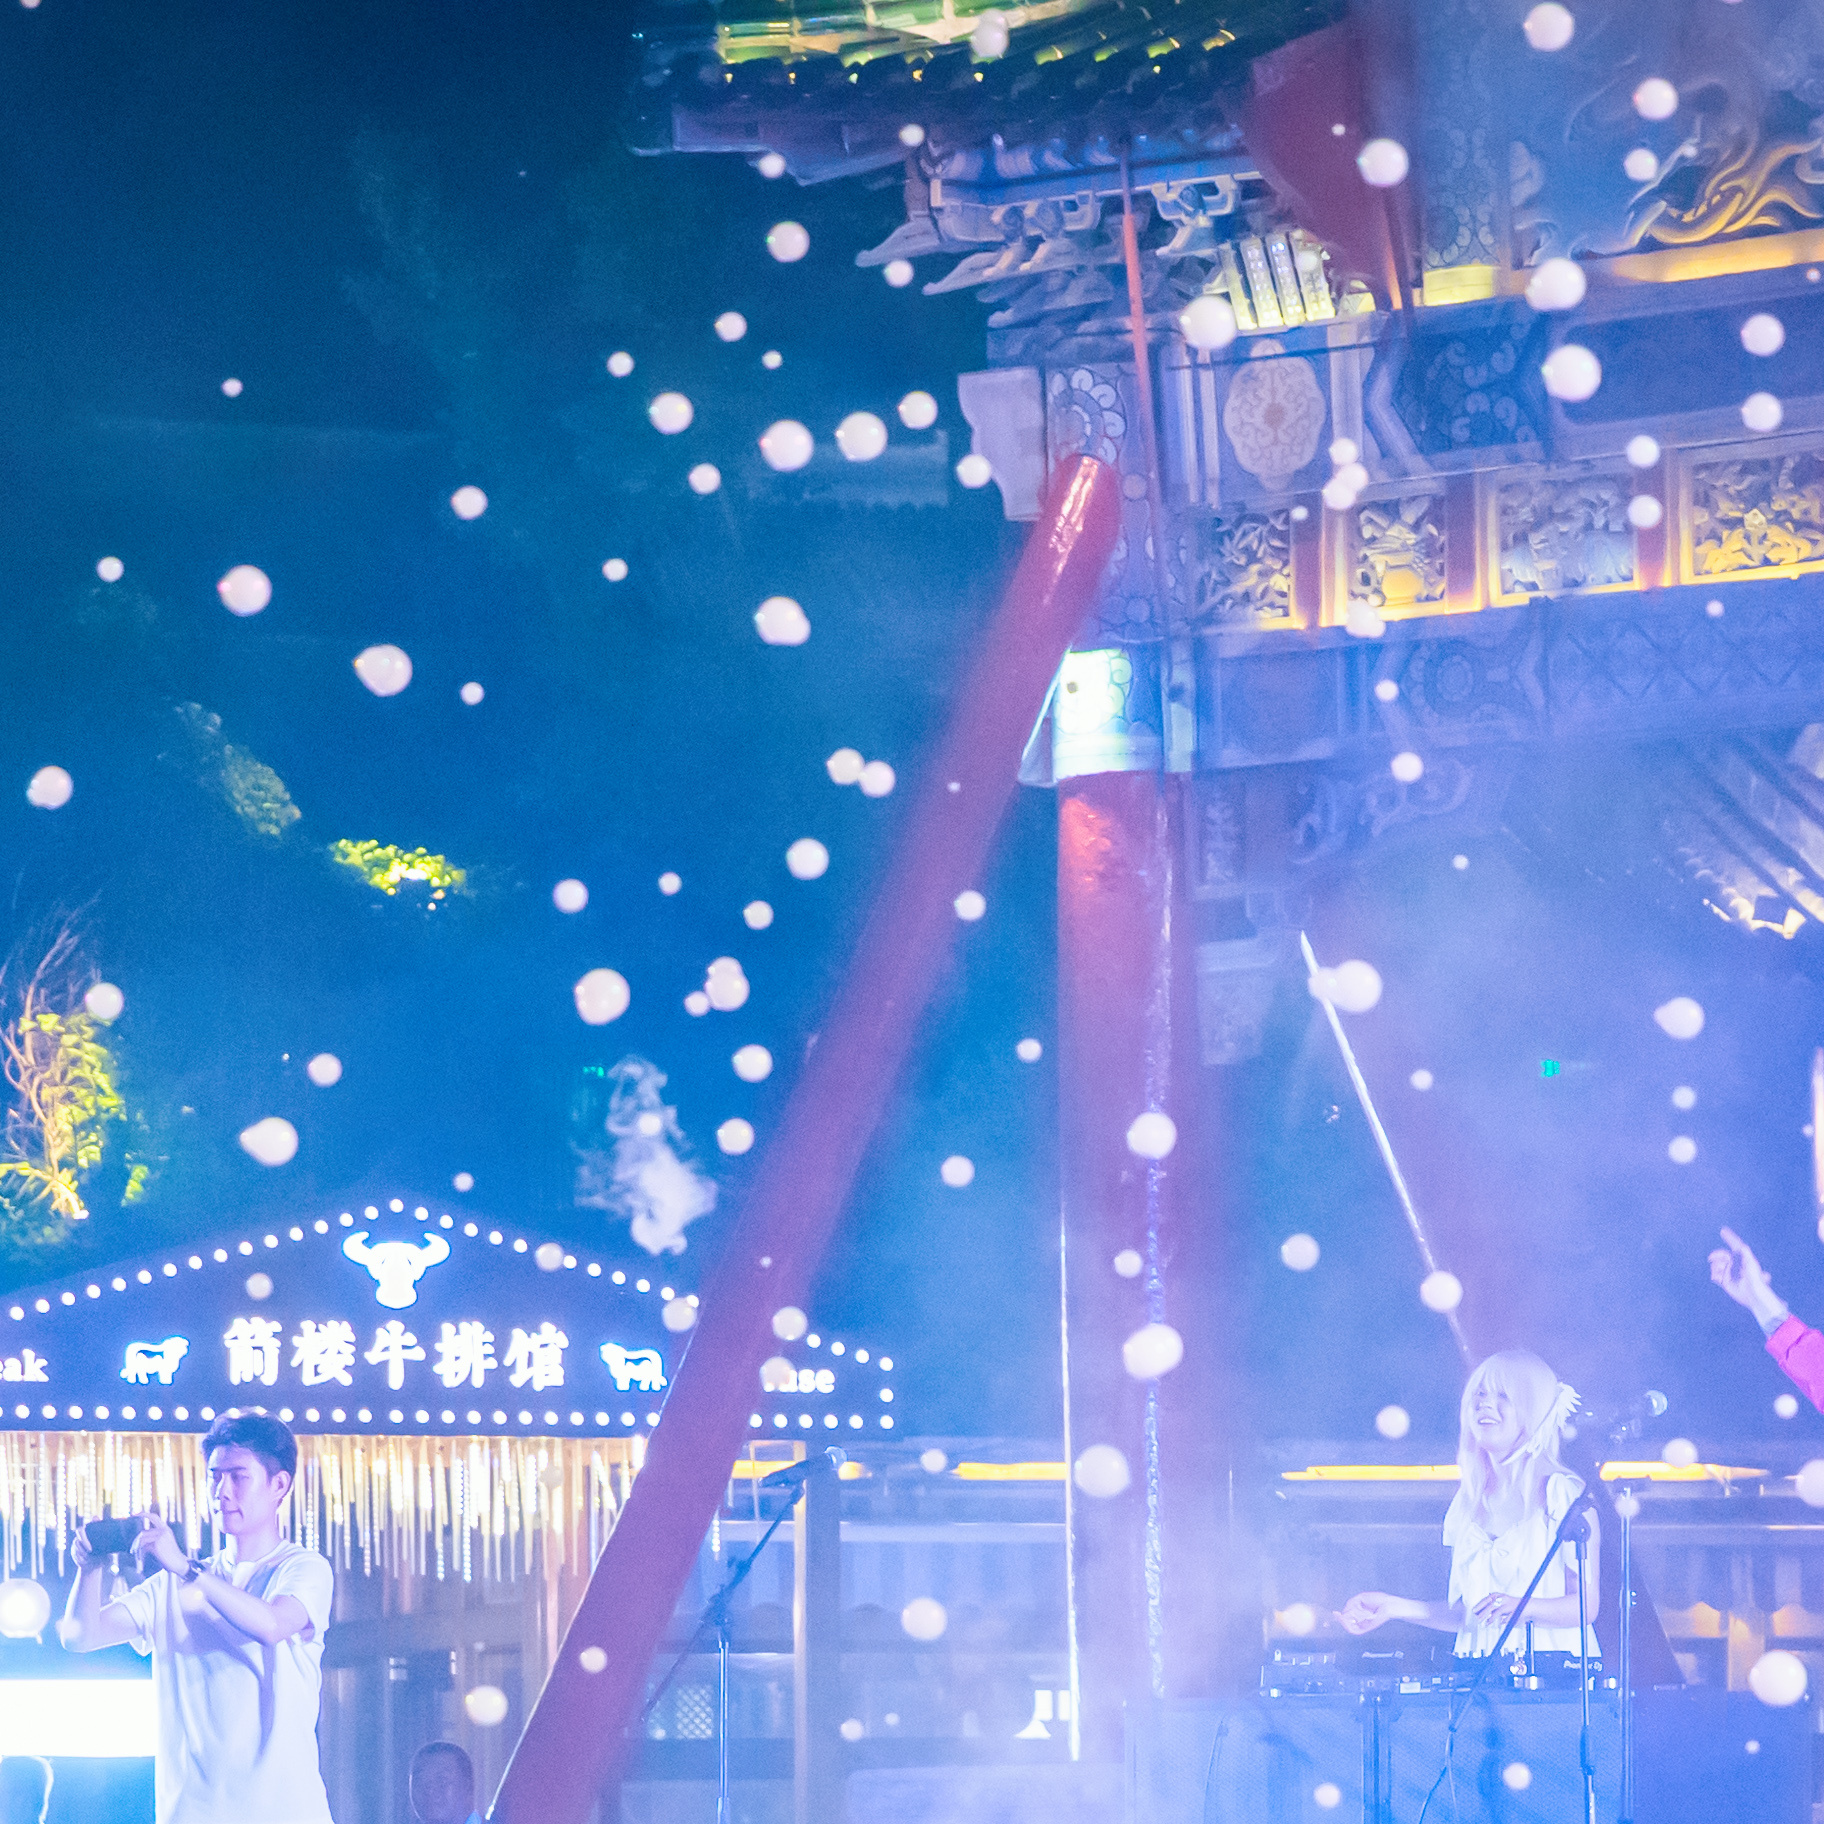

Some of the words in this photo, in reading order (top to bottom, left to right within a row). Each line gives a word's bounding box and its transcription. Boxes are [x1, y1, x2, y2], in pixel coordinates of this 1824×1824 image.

[223, 1316, 570, 1392] 箭楼牛排馆
[761, 1368, 836, 1394] use
